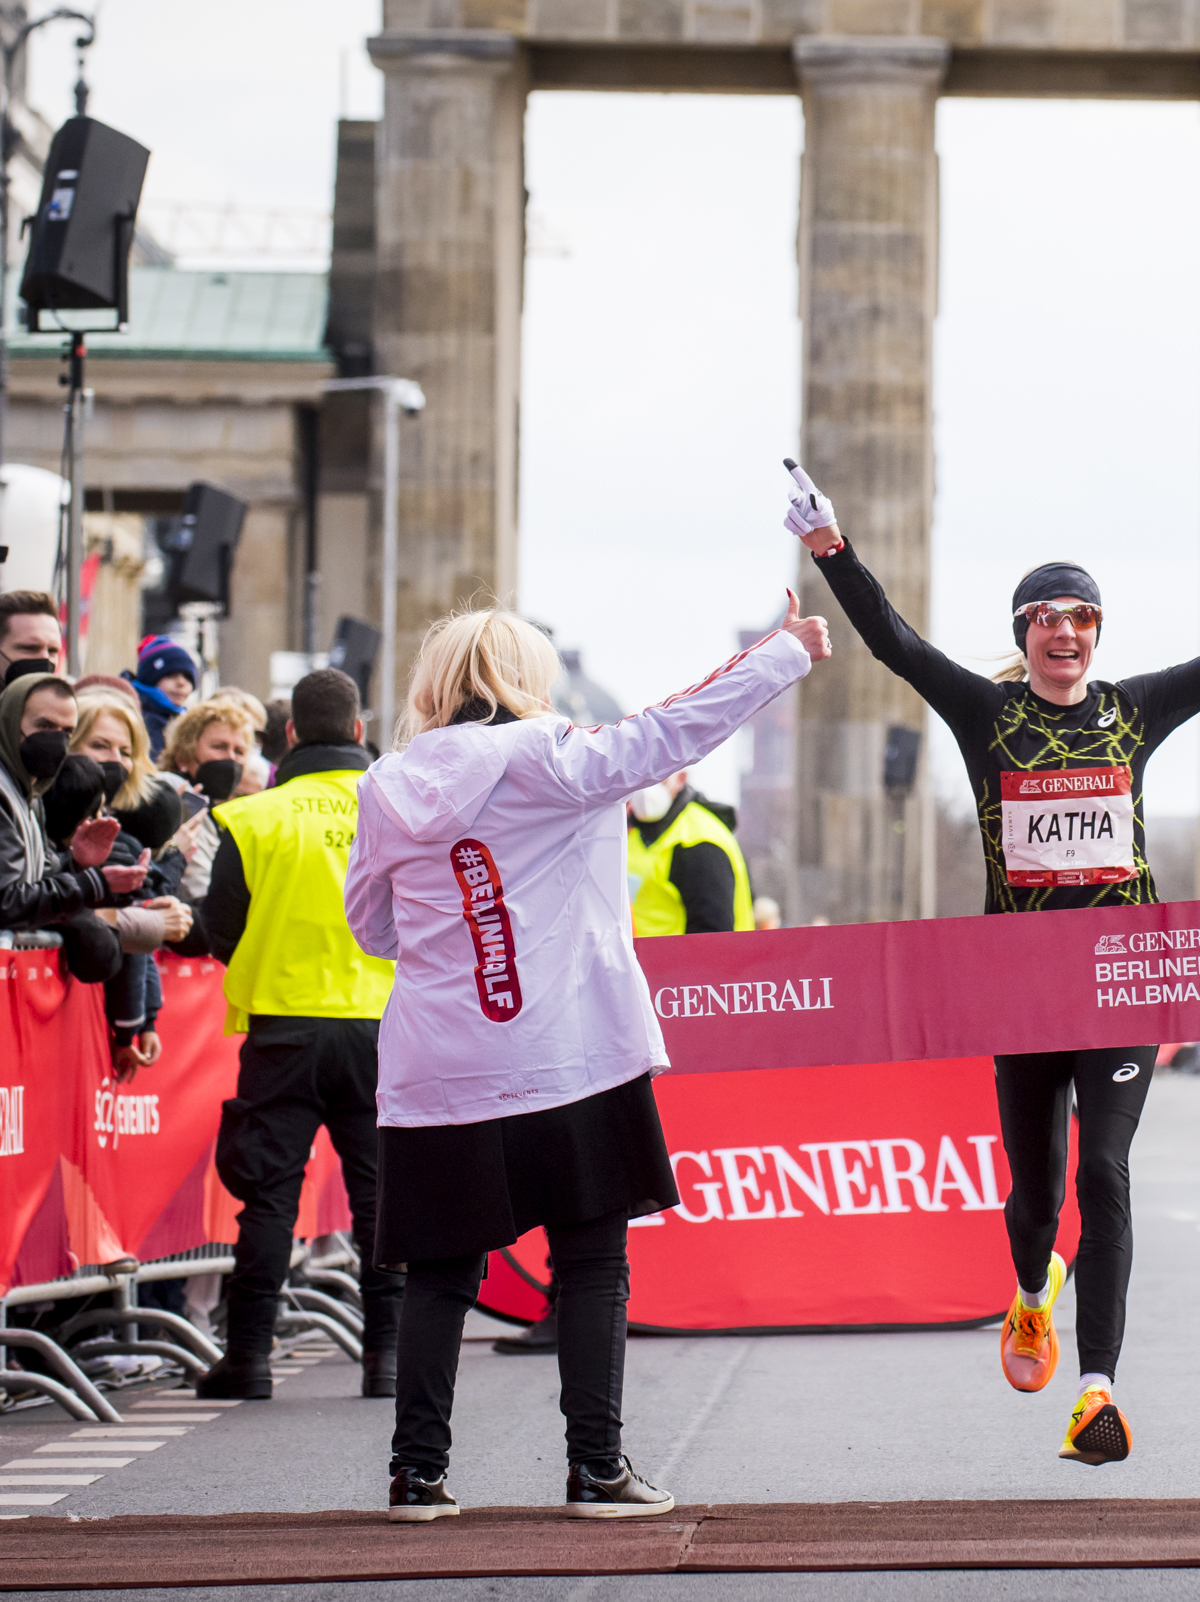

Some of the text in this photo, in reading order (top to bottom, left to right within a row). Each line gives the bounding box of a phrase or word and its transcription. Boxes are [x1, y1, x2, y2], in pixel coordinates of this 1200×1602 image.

[1042, 775, 1115, 793] GENERALI
[1027, 811, 1114, 843] KATHA
[1065, 849, 1076, 858] F9
[654, 977, 835, 1019] GENERALI
